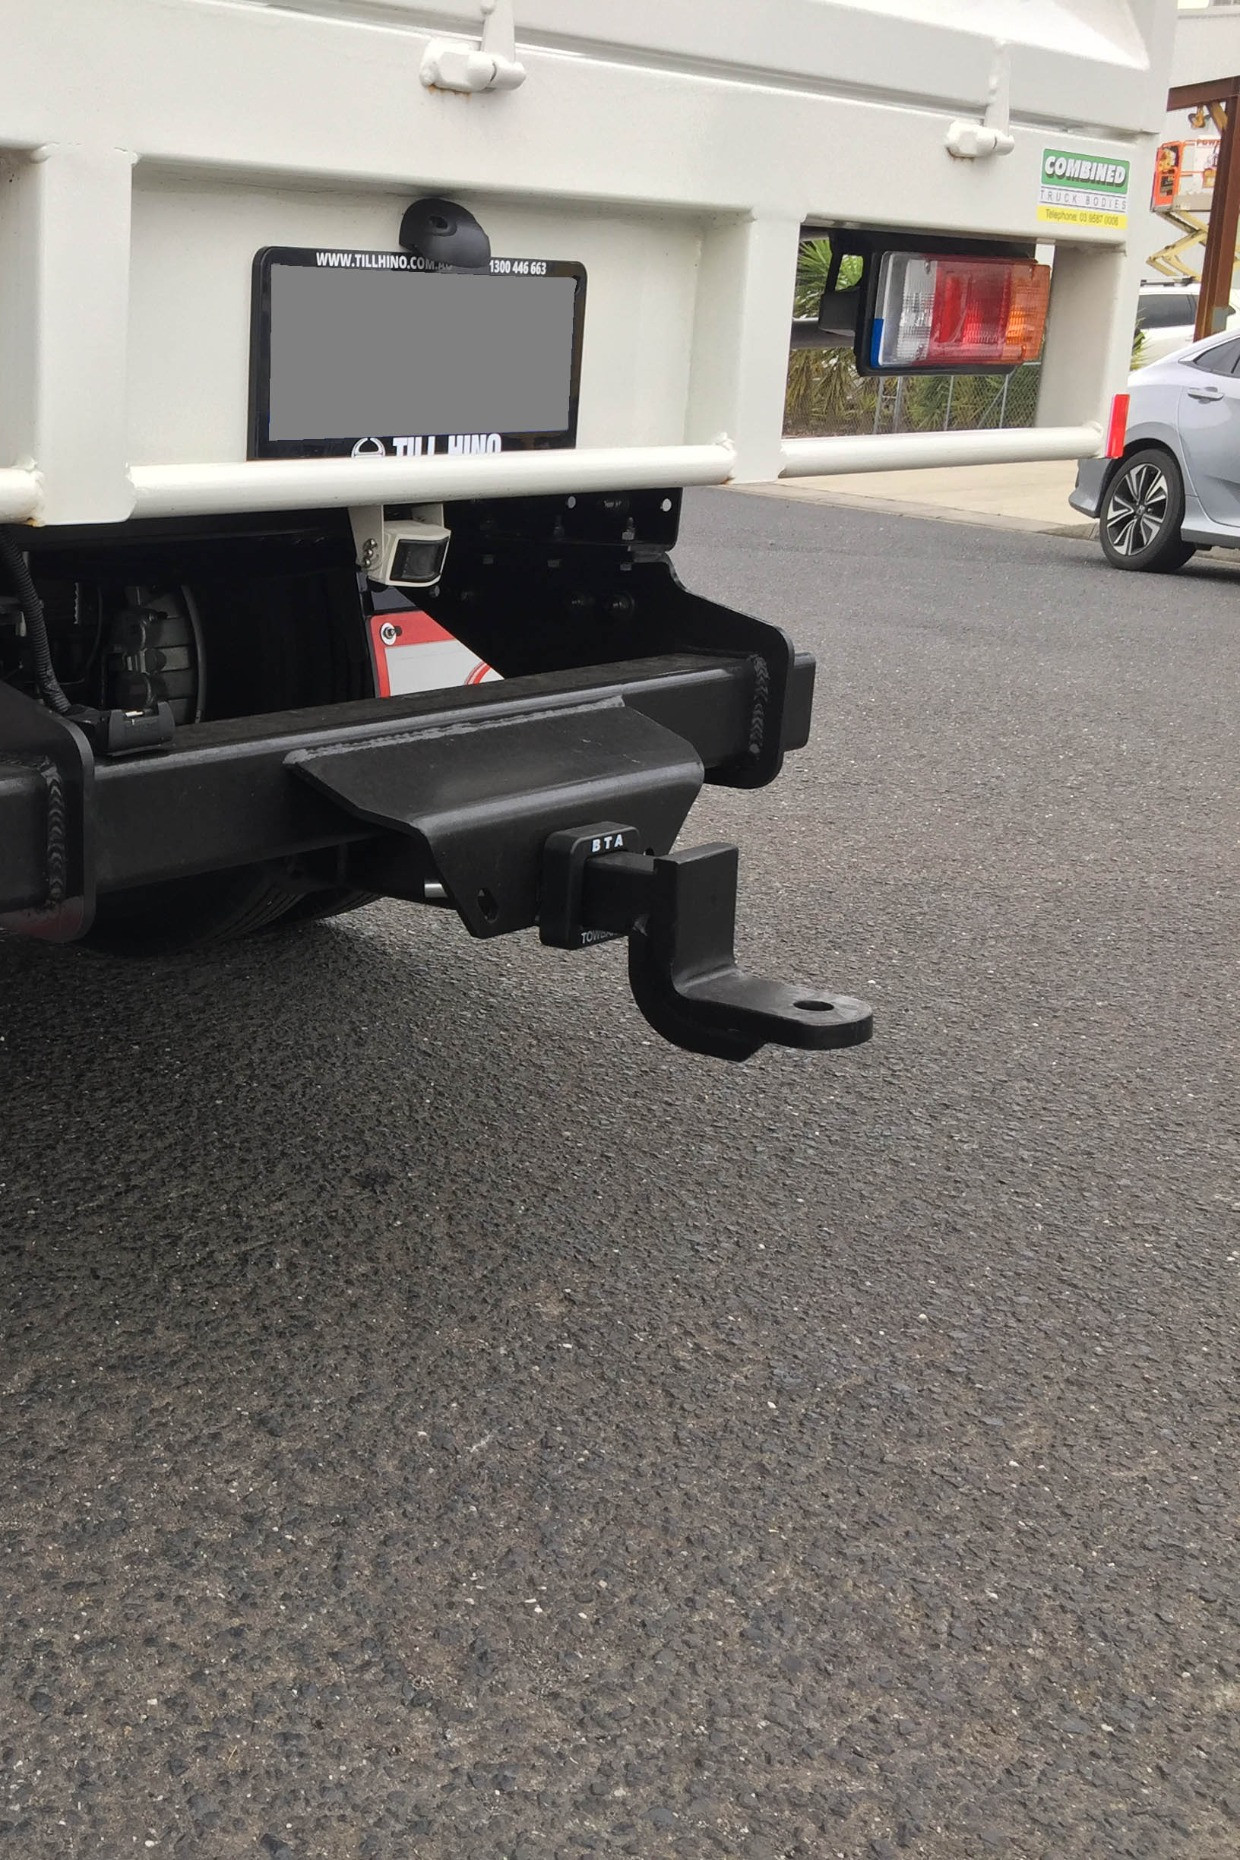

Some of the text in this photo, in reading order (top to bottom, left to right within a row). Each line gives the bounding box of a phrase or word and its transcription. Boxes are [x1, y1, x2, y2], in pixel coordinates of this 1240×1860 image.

[1044, 156, 1126, 186] COMBINED
[1041, 189, 1126, 210] TRUCK BODIES
[489, 259, 510, 273] 1300
[512, 261, 528, 275] 446
[530, 262, 546, 275] 663
[448, 433, 502, 457] HINO
[591, 833, 624, 853] BTA
